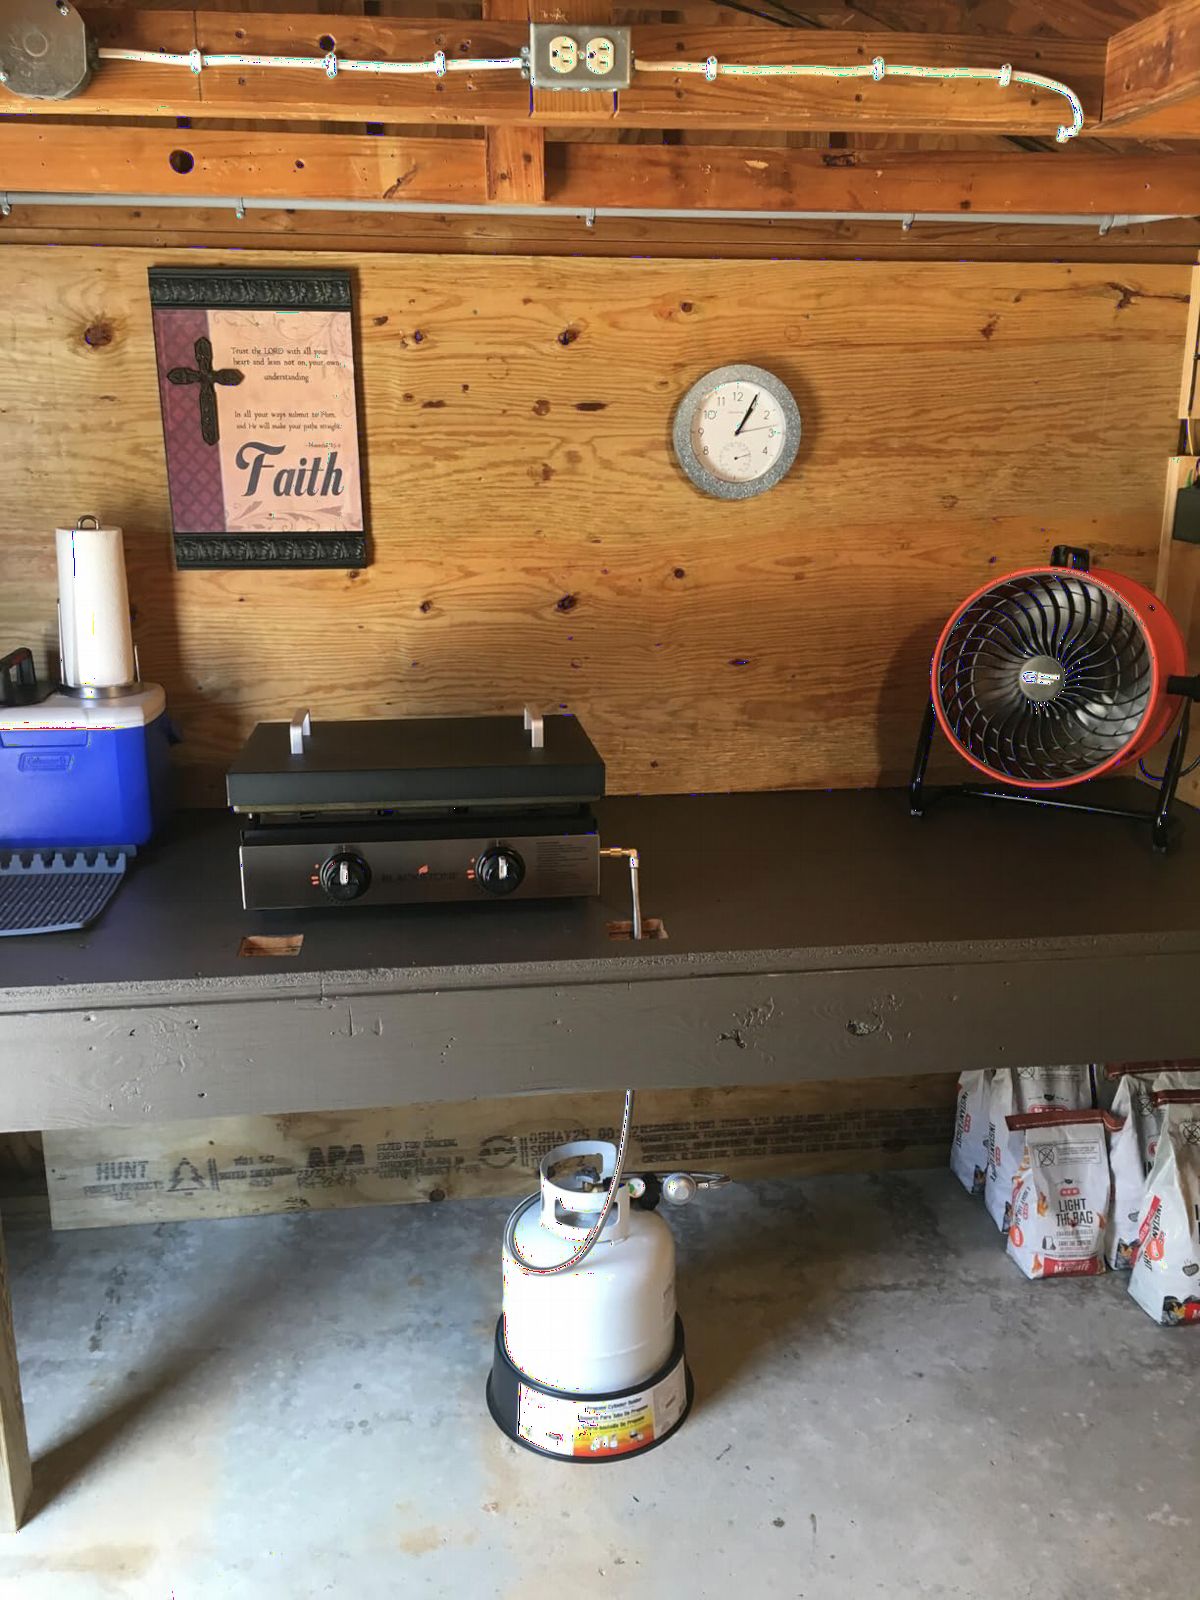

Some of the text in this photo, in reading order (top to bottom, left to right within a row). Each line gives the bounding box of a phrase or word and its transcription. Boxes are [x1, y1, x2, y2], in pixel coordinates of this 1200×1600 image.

[231, 346, 328, 358] Trust the LORD with all your
[233, 358, 250, 367] heart
[253, 358, 264, 366] and
[268, 358, 280, 366] lean
[308, 360, 323, 368] your
[717, 396, 725, 406] 11
[733, 392, 743, 402] 12
[254, 412, 268, 421] your
[271, 412, 286, 421] ways
[288, 410, 309, 418] submit
[704, 410, 716, 420] 10
[764, 410, 770, 420] 2
[259, 422, 270, 430] will
[272, 422, 286, 430] make
[289, 424, 301, 432] your
[698, 428, 704, 437] 9
[769, 429, 774, 438] 3
[703, 446, 709, 455] 8
[762, 446, 768, 455] 4
[235, 441, 344, 497] Faith
[96, 1160, 149, 1181] HUNT
[1058, 1198, 1086, 1213] LIGHT
[1056, 1211, 1093, 1227] THE BAG
